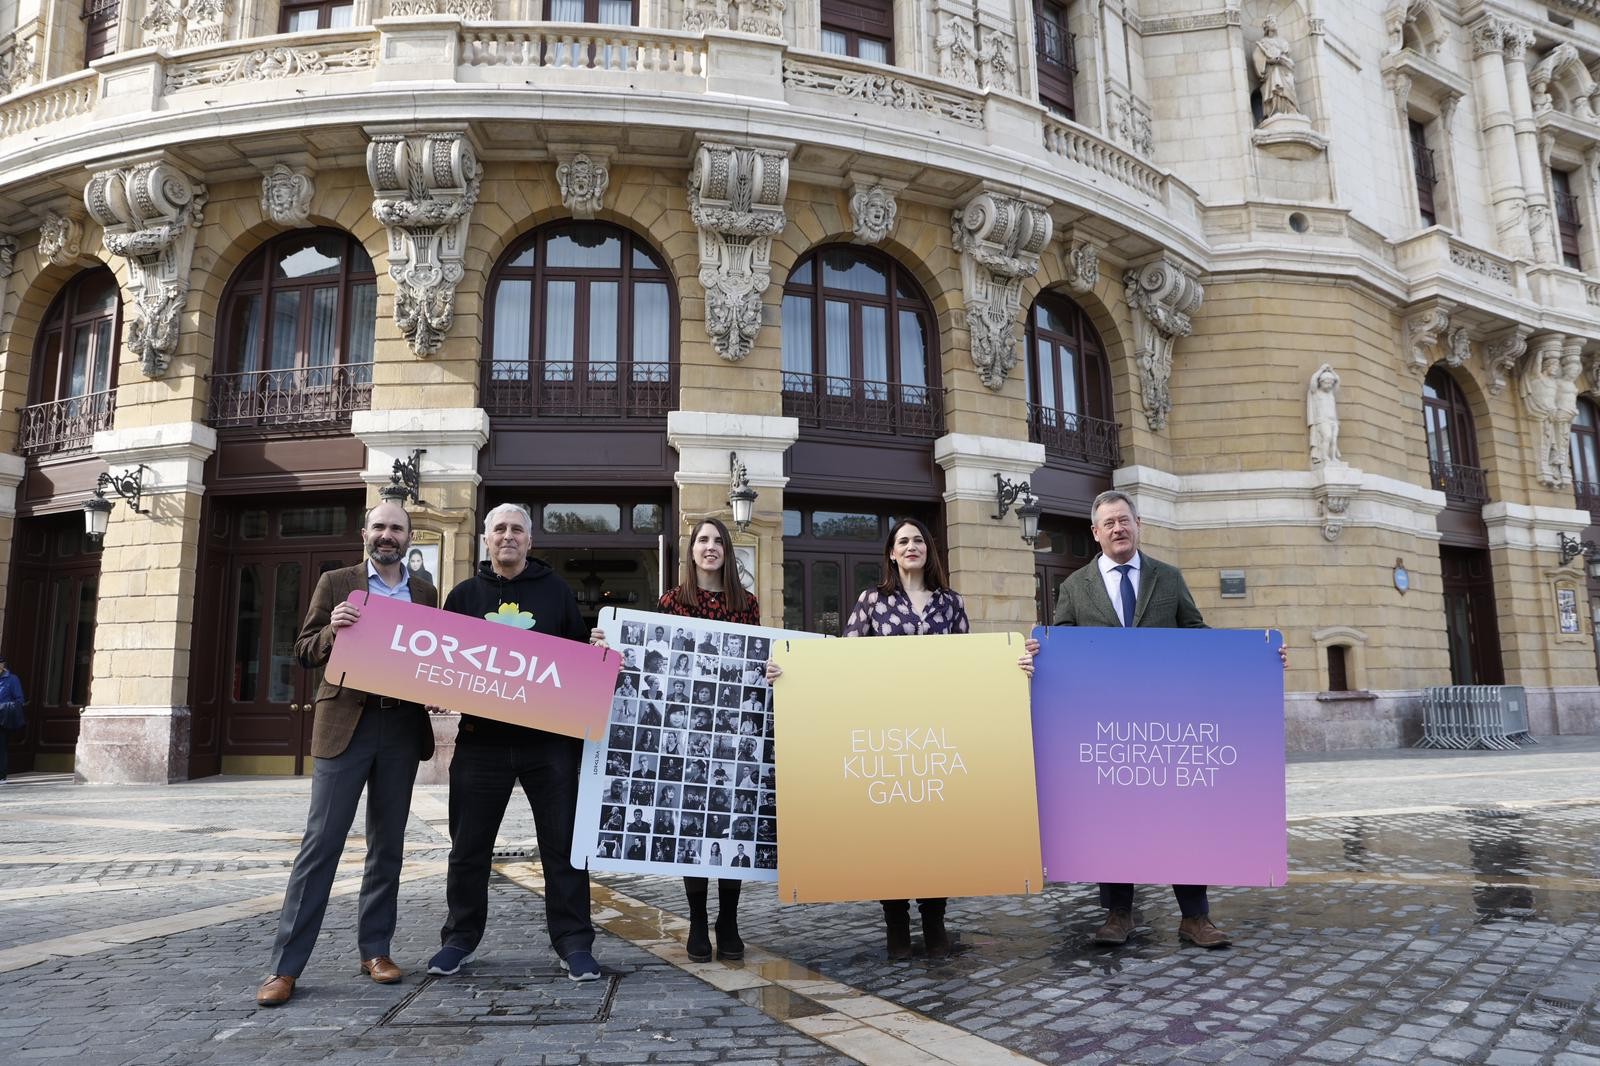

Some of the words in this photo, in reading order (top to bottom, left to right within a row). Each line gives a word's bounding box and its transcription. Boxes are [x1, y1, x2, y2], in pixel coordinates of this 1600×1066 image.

[415, 662, 527, 703] FESTIBALA
[852, 727, 957, 752] EUSKAL
[1096, 721, 1219, 743] MUNDUARI
[843, 751, 968, 779] KULTURA
[1079, 743, 1237, 766] BEGIRATZEKO
[1097, 765, 1167, 786] MODU
[1176, 767, 1220, 788] BAT
[868, 778, 944, 805] GAUR
